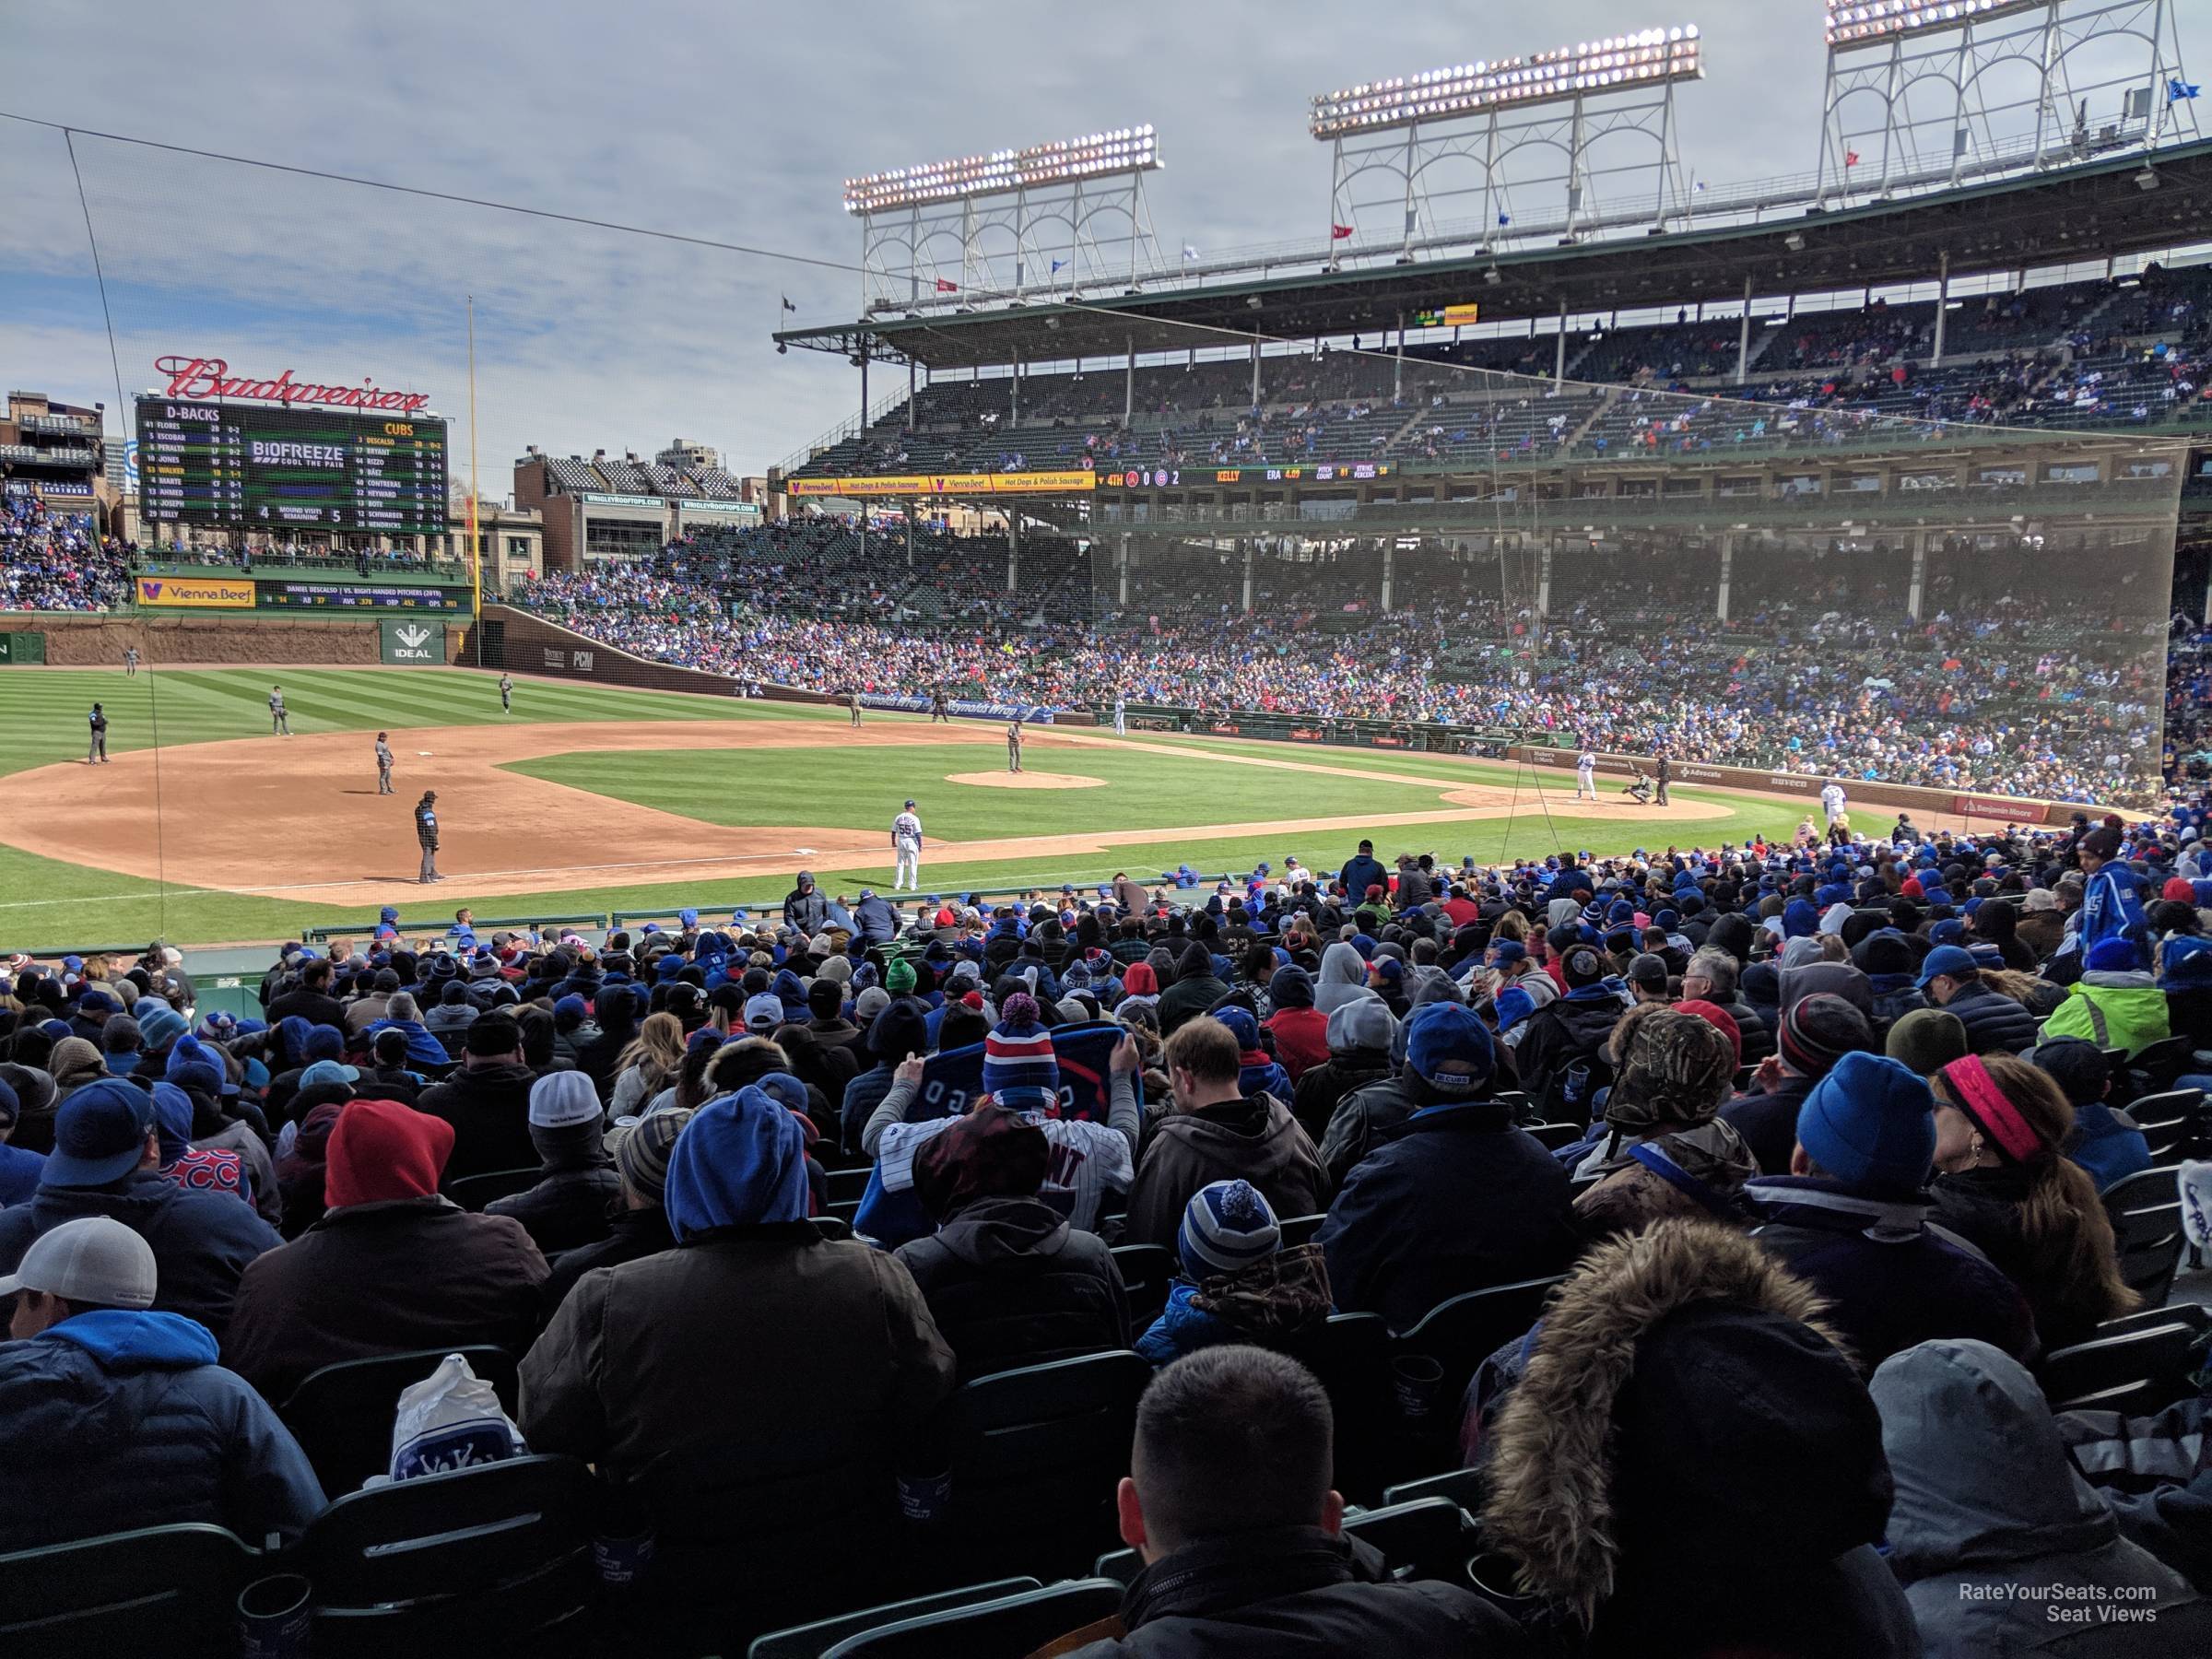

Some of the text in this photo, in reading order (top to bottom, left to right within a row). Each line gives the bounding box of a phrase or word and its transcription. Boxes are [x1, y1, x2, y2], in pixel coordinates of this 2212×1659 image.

[155, 356, 429, 411] Budweiser
[167, 406, 220, 422] D-BACKS
[157, 421, 181, 430] FLORES
[385, 423, 414, 436] CUBS
[158, 433, 186, 441] ESCOBAR
[367, 437, 395, 445] DESCALSO
[159, 444, 185, 453] PERALTA
[159, 455, 180, 464] JONES
[159, 466, 185, 475] WALKER
[1217, 470, 1240, 482] KELLY
[1266, 470, 1281, 480] ERA
[159, 477, 182, 486] MARTE
[368, 479, 401, 488] CONTRERAS
[948, 479, 971, 488] Vienna
[1017, 478, 1032, 487] Dogs
[1059, 477, 1084, 486] Sausage
[1107, 471, 1179, 487] 4TH 0 2
[160, 500, 184, 508] JOSEPH
[588, 494, 662, 506] WRIGLEYROOFTOPS.COM
[684, 501, 755, 512] WRIGLEYROOFTOPS.COM
[260, 506, 269, 519] 4
[333, 510, 341, 523] 5
[170, 586, 252, 604] Vienna Beef
[394, 649, 432, 658] IDEAL
[573, 651, 594, 668] PCM
[898, 697, 923, 711] Wrap
[947, 700, 990, 714] Reynolds
[988, 703, 1018, 719] Wrap
[1689, 769, 1722, 779] Advocate
[1771, 777, 1807, 788] nuveen
[1977, 804, 2033, 818] Benjamin Moore
